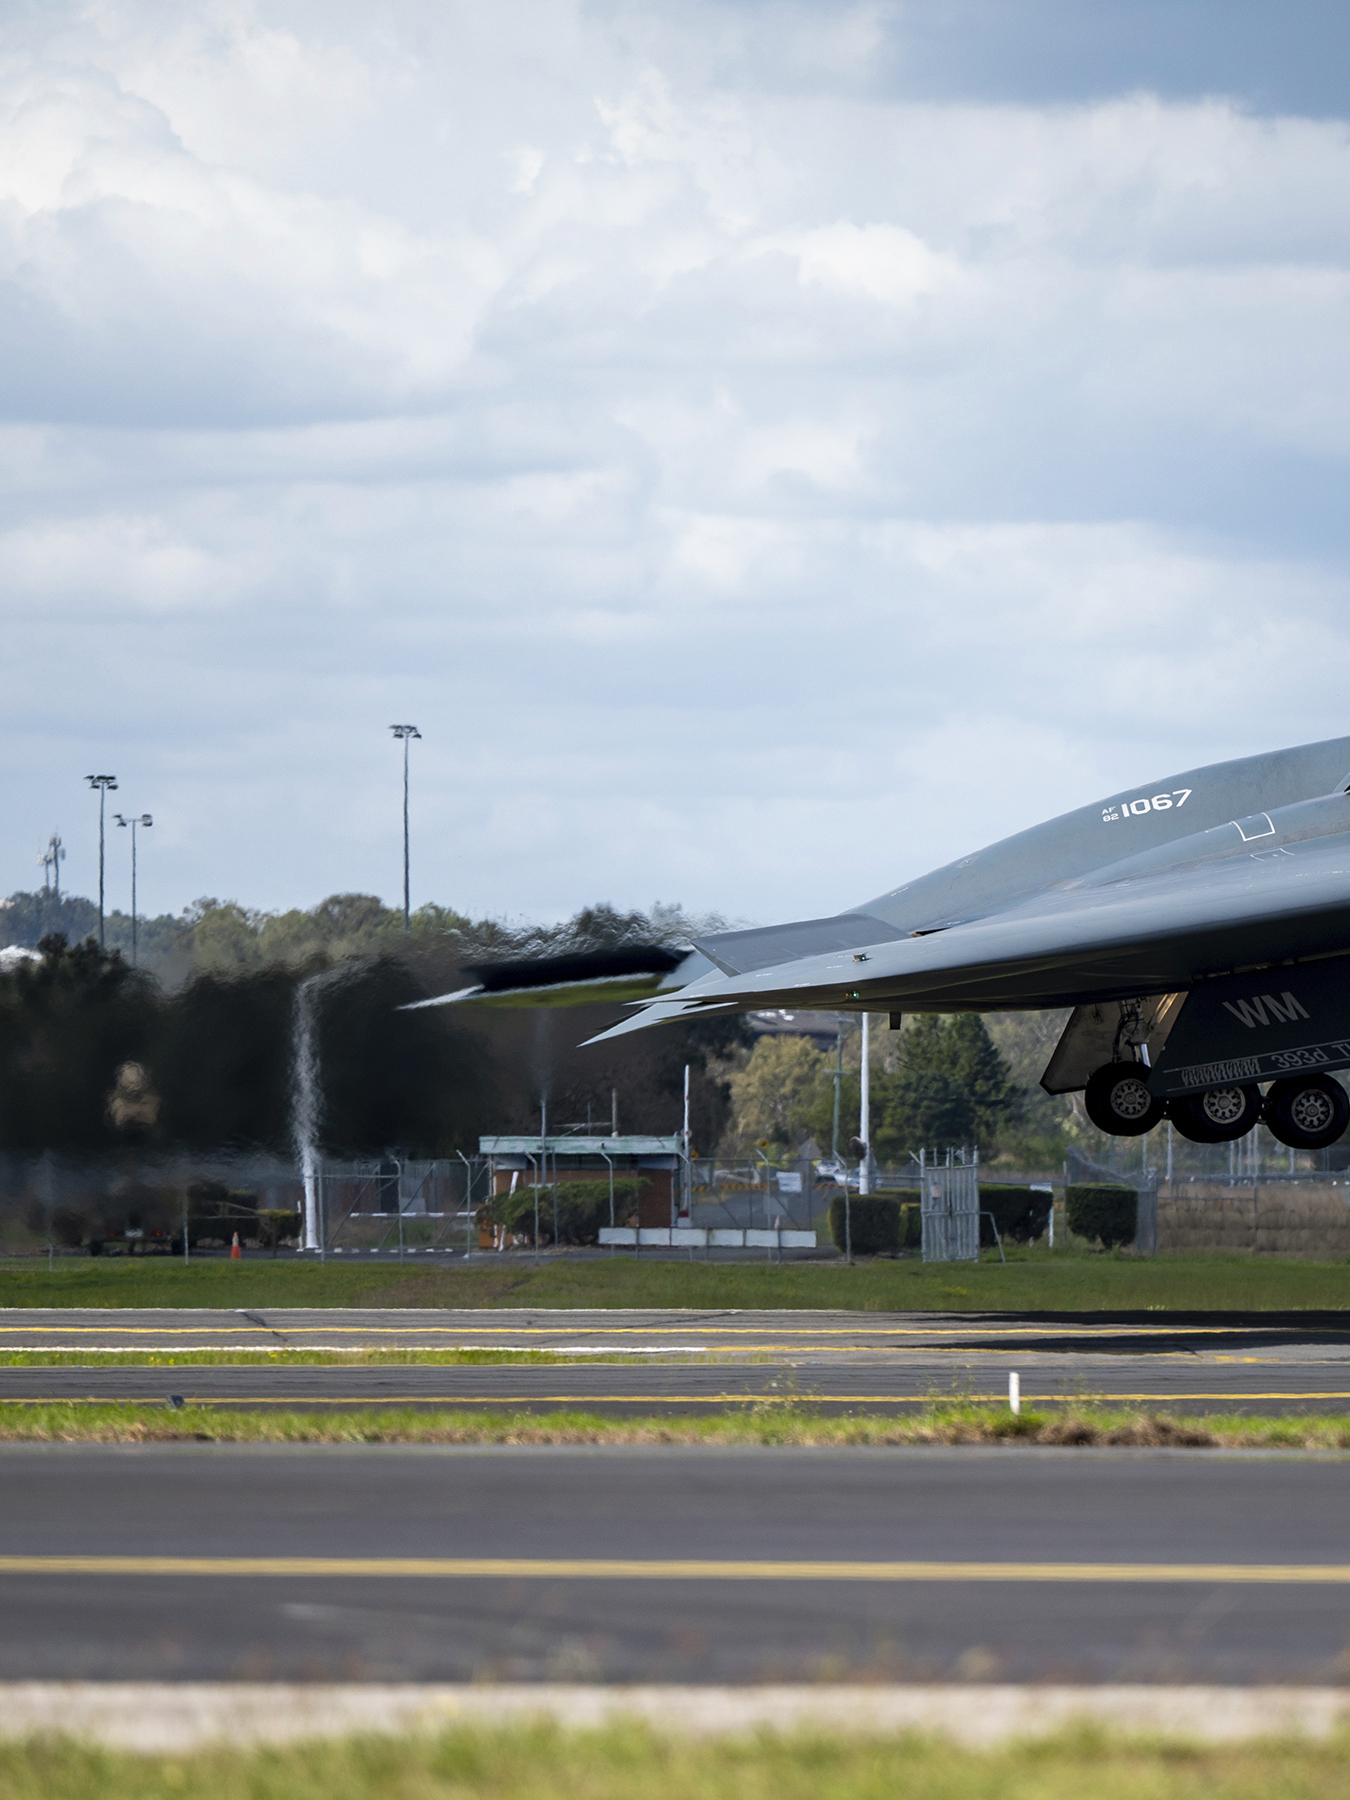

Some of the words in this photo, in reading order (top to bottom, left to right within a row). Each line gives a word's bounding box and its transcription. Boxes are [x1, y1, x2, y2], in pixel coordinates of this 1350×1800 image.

[1102, 806, 1116, 815] AF
[1121, 788, 1192, 818] 1067
[1222, 991, 1310, 1029] WM
[1271, 1049, 1329, 1069] 393d
